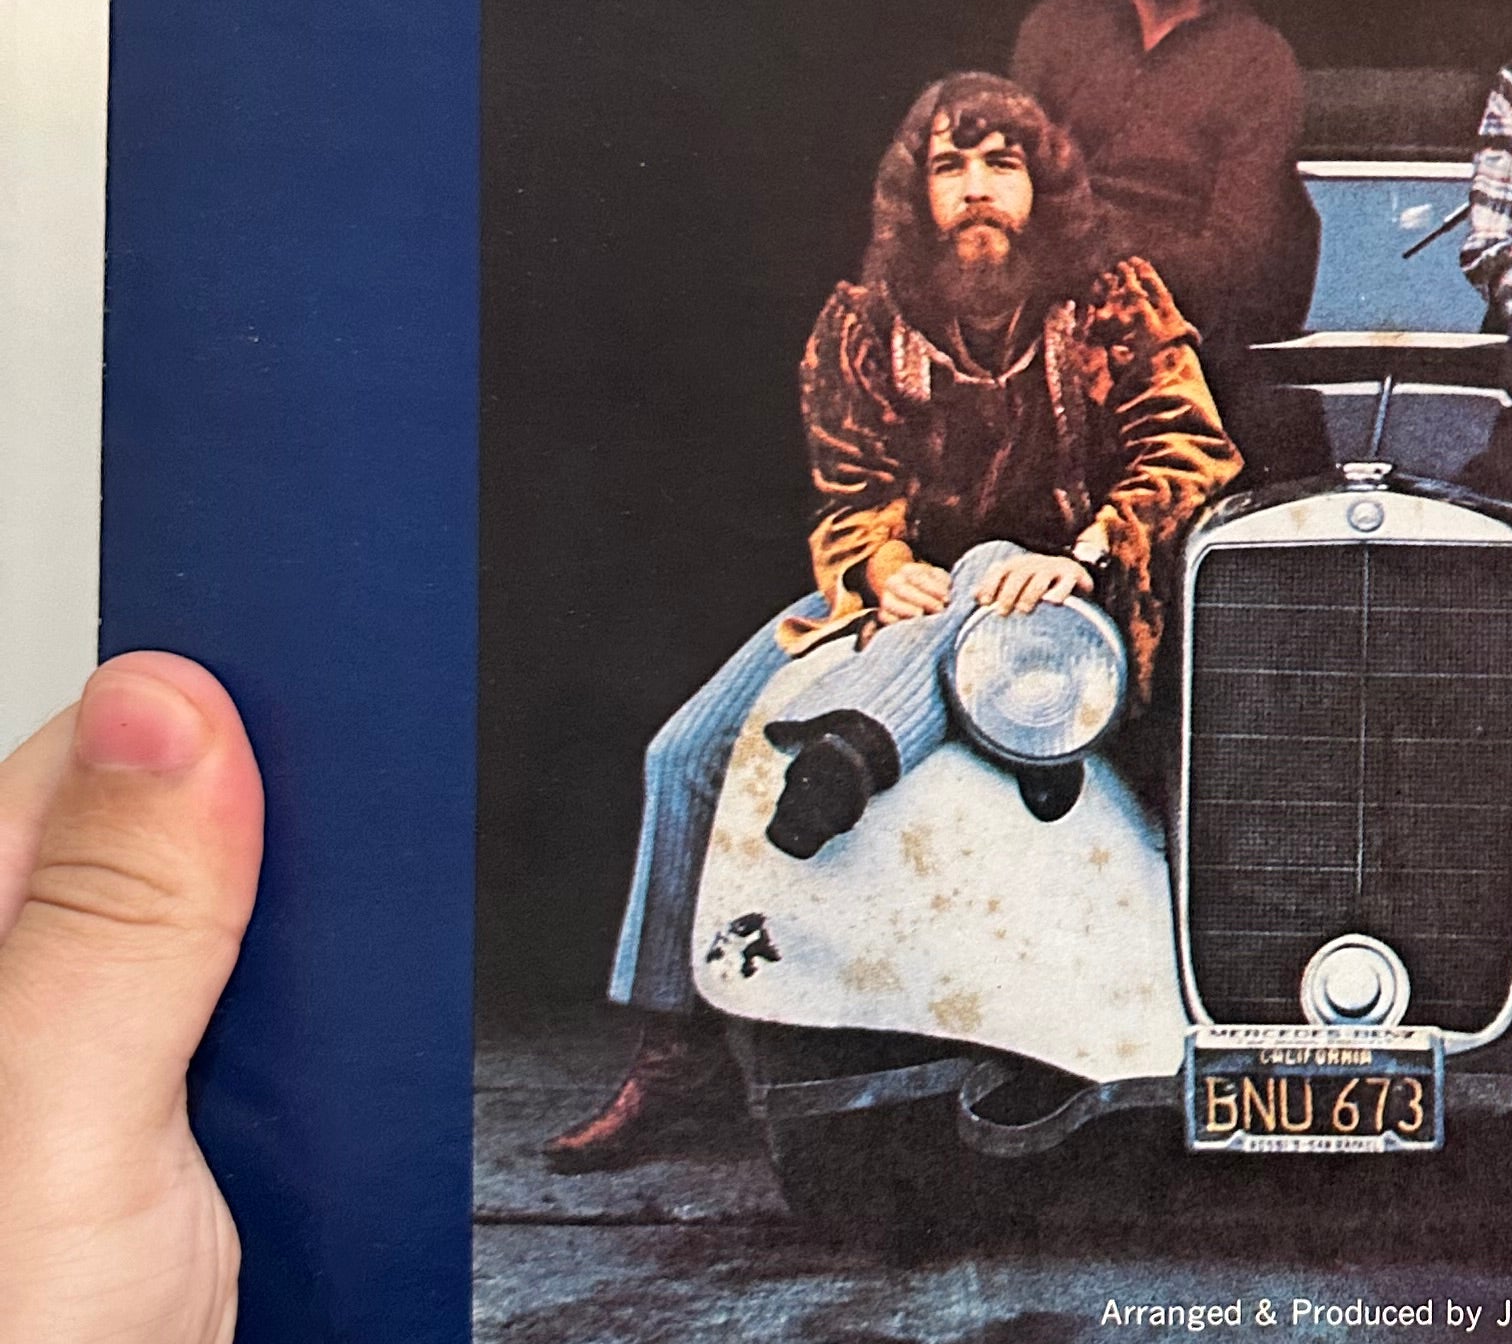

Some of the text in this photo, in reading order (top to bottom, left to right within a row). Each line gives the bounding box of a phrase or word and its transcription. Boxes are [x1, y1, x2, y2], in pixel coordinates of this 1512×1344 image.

[1205, 1076, 1424, 1132] BNU 673
[1101, 1299, 1242, 1332] Arranged
[1255, 1298, 1278, 1326] &
[1292, 1298, 1433, 1327] Produced
[1446, 1298, 1483, 1333] by
